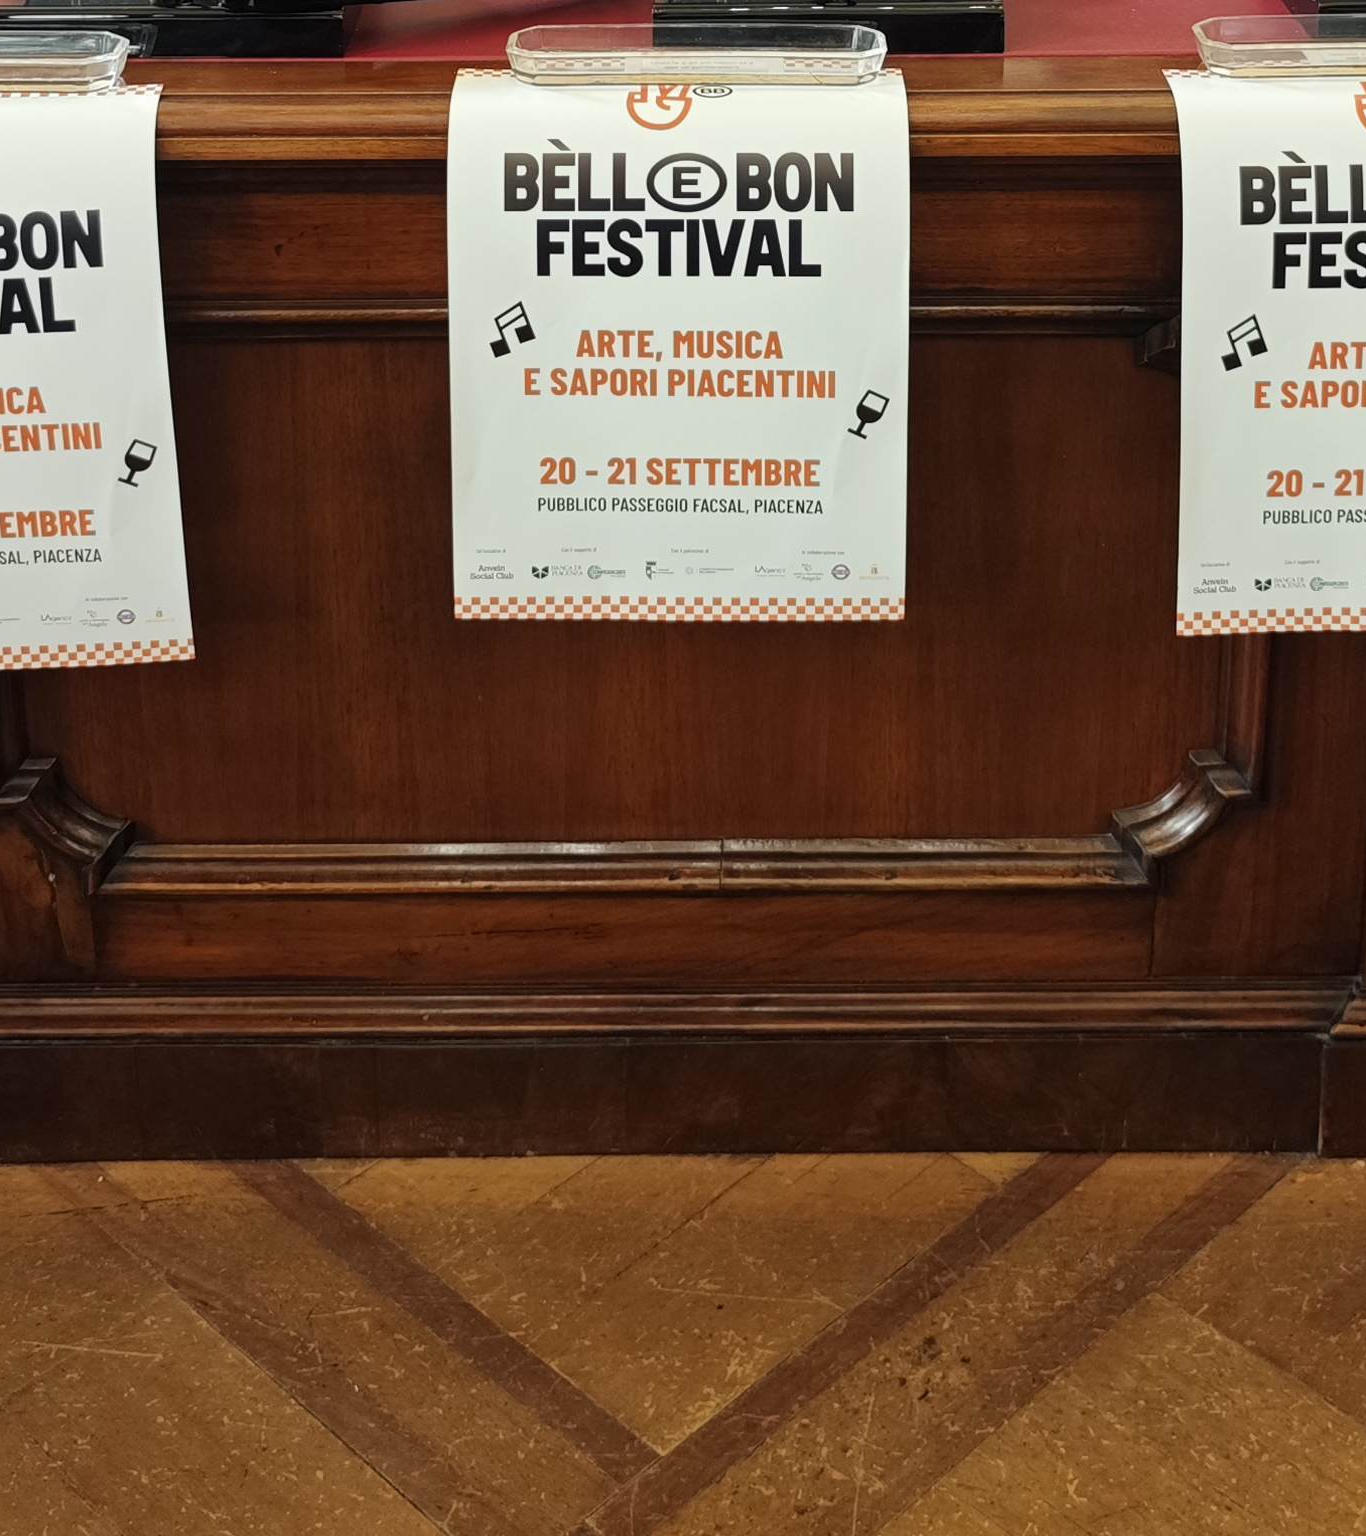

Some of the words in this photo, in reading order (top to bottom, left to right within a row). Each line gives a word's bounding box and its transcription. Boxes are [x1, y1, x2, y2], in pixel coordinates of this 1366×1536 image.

[504, 139, 646, 212] BÈLL
[736, 152, 854, 212] BON
[537, 218, 821, 277] FESTIVAL
[576, 330, 662, 362] ARTE,
[673, 331, 783, 359] MUSICA
[524, 368, 540, 395] E
[550, 368, 657, 396] SAPORI
[668, 369, 835, 398] PIACENTINI
[1254, 381, 1271, 409] E
[540, 457, 576, 485] 20
[608, 458, 636, 485] 21
[646, 458, 820, 487] SETTEMBRE
[1267, 470, 1303, 497] 20
[1334, 469, 1364, 496] 21
[538, 497, 606, 512] PUBBLICO
[612, 498, 688, 512] PASSEGGIO
[693, 498, 749, 514] FACSAL,
[755, 499, 823, 514] PIACENZA
[1263, 509, 1332, 525] PUBBLICO
[33, 549, 102, 564] PIACENZA
[1193, 585, 1218, 594] Social
[1219, 584, 1237, 593] Club
